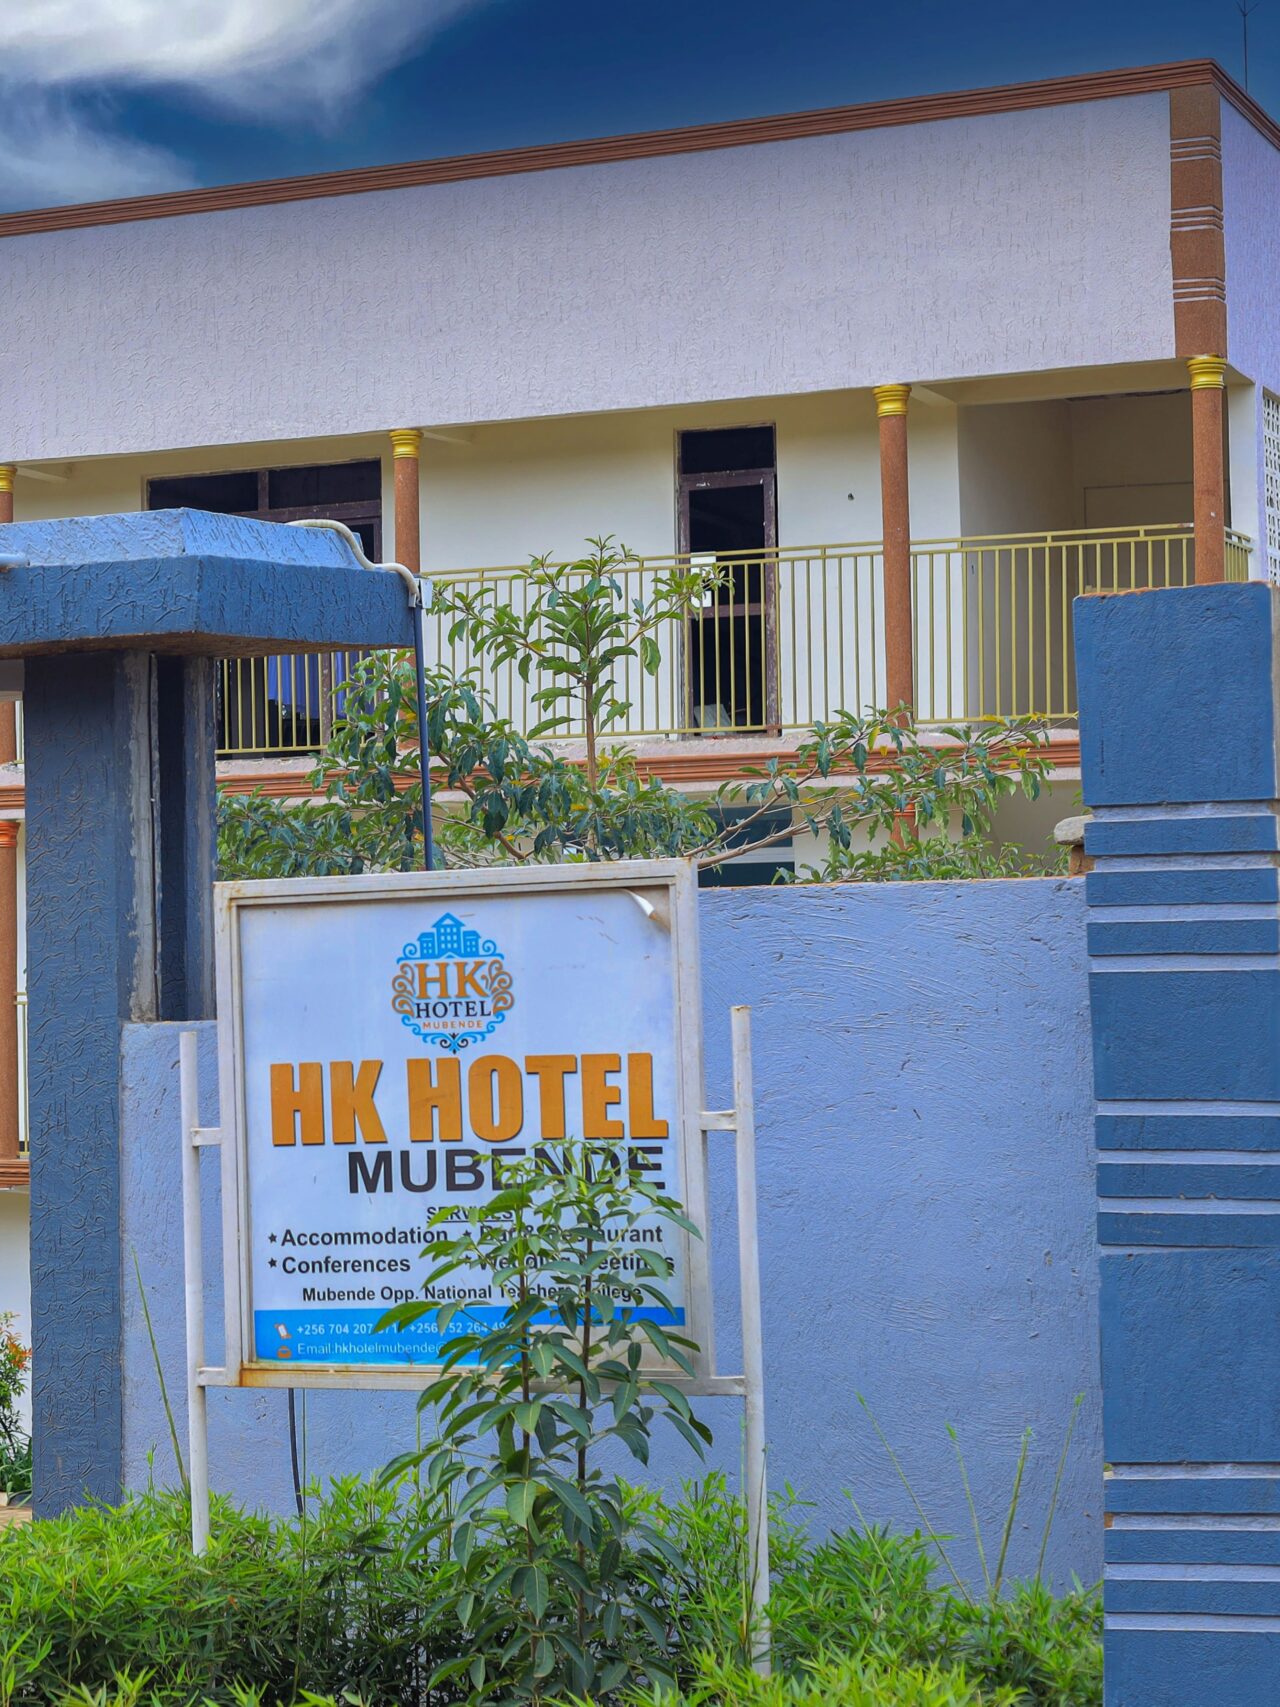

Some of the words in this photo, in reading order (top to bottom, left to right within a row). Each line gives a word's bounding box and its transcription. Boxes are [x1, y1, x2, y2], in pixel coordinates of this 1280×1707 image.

[416, 960, 490, 1000] HK
[415, 1001, 493, 1019] HOTEL
[422, 1020, 483, 1030] MUBENDE
[270, 1059, 388, 1147] HK
[406, 1052, 670, 1143] HOTEL
[348, 1145, 667, 1194] MUBENDE
[281, 1227, 448, 1246] Accommodation
[282, 1255, 411, 1274] Conferences
[303, 1286, 375, 1301] Mubende
[380, 1286, 419, 1303] Opp.
[424, 1284, 492, 1300] National
[297, 1324, 325, 1335] +256
[328, 1324, 350, 1335] 704
[353, 1323, 374, 1335] 207
[409, 1322, 439, 1334] +256
